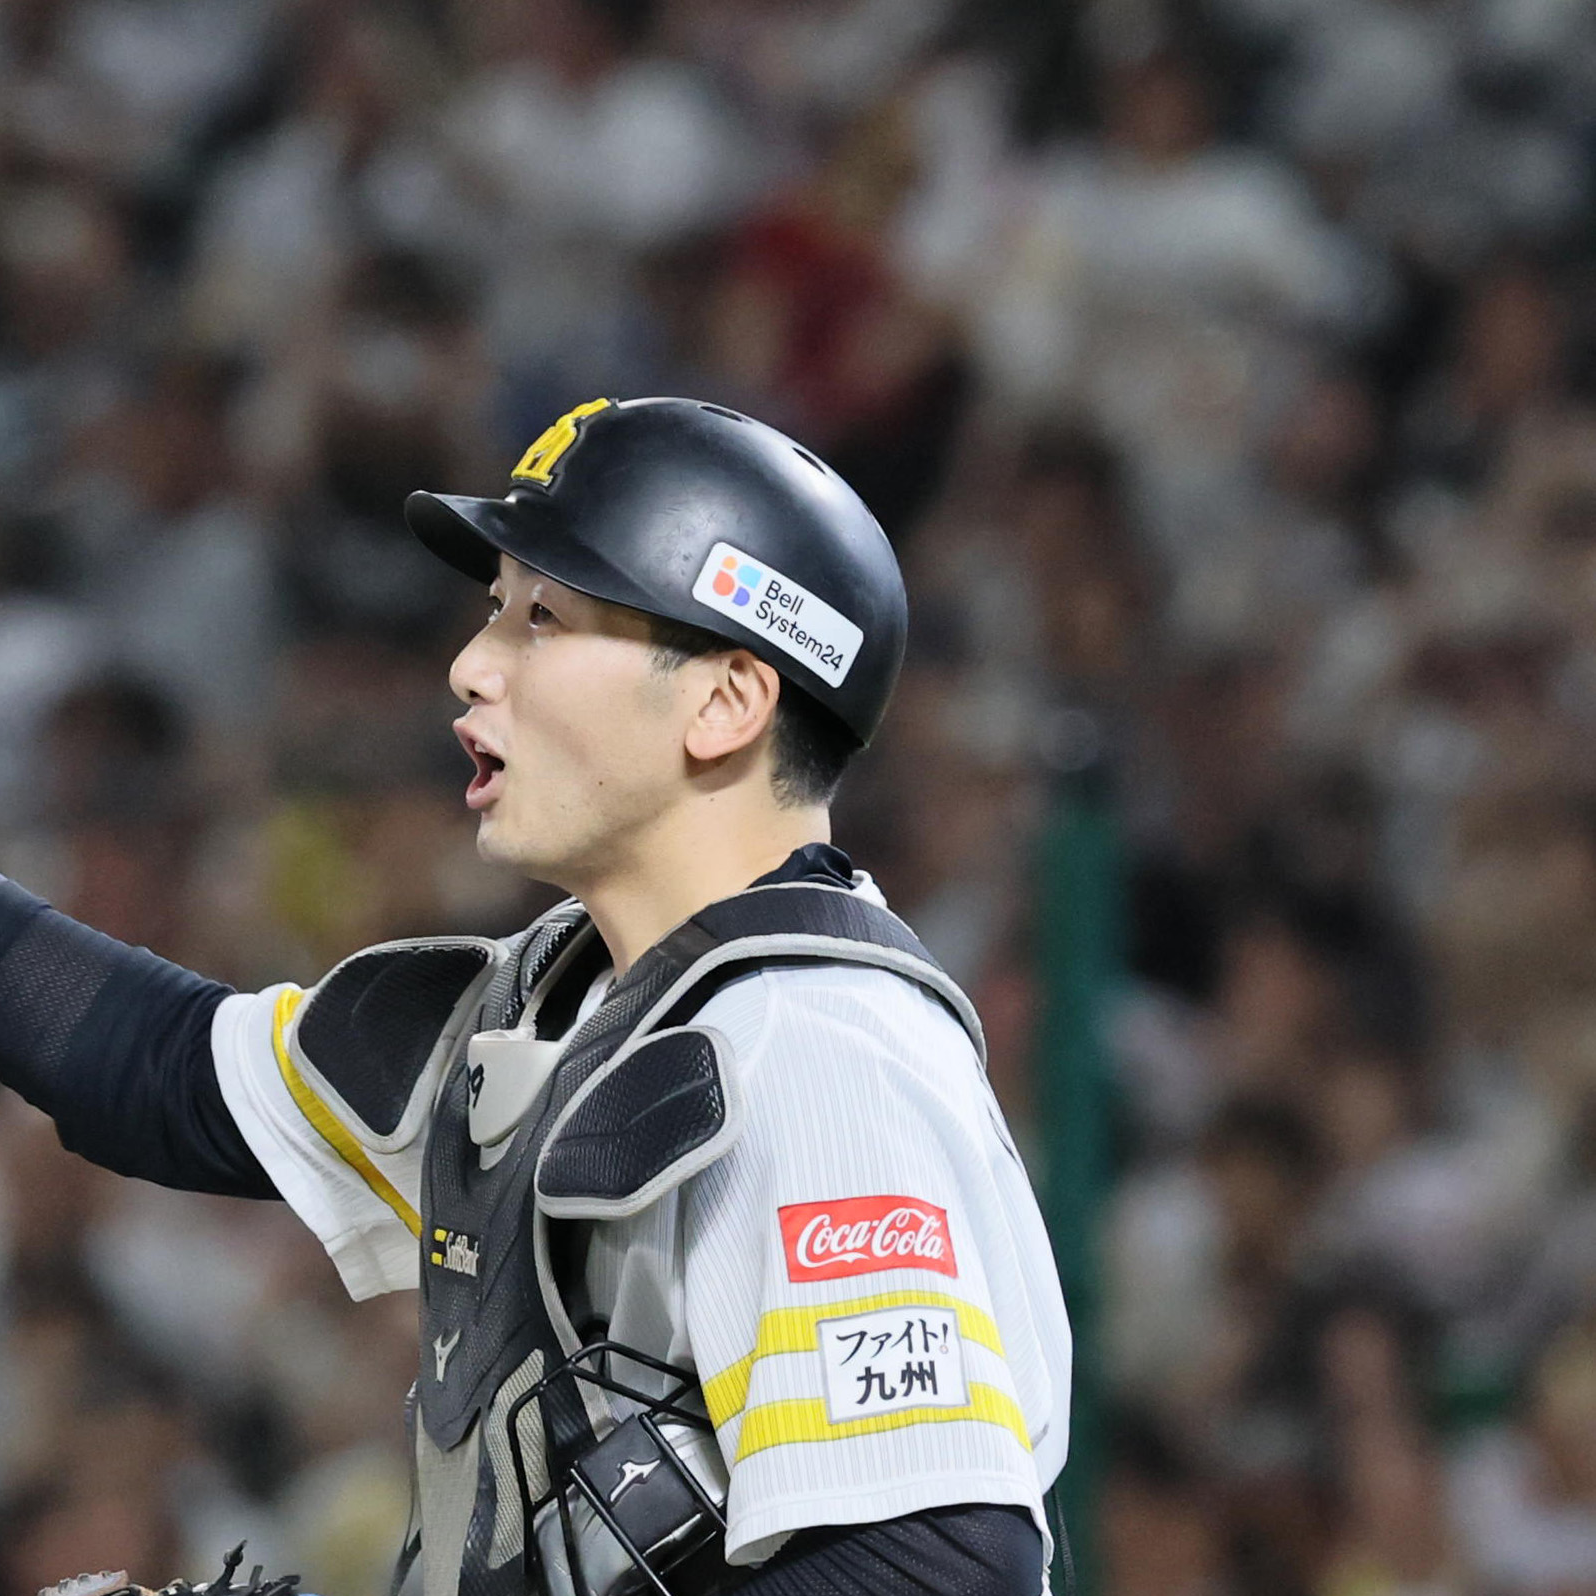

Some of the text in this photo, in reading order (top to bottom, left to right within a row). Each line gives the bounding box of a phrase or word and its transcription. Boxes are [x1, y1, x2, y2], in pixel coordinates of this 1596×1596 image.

[765, 579, 804, 616] Bell
[756, 600, 844, 672] System24
[795, 1207, 945, 1268] Coca-Cola
[835, 1318, 949, 1367] ファイト!
[855, 1360, 938, 1405] 九州
